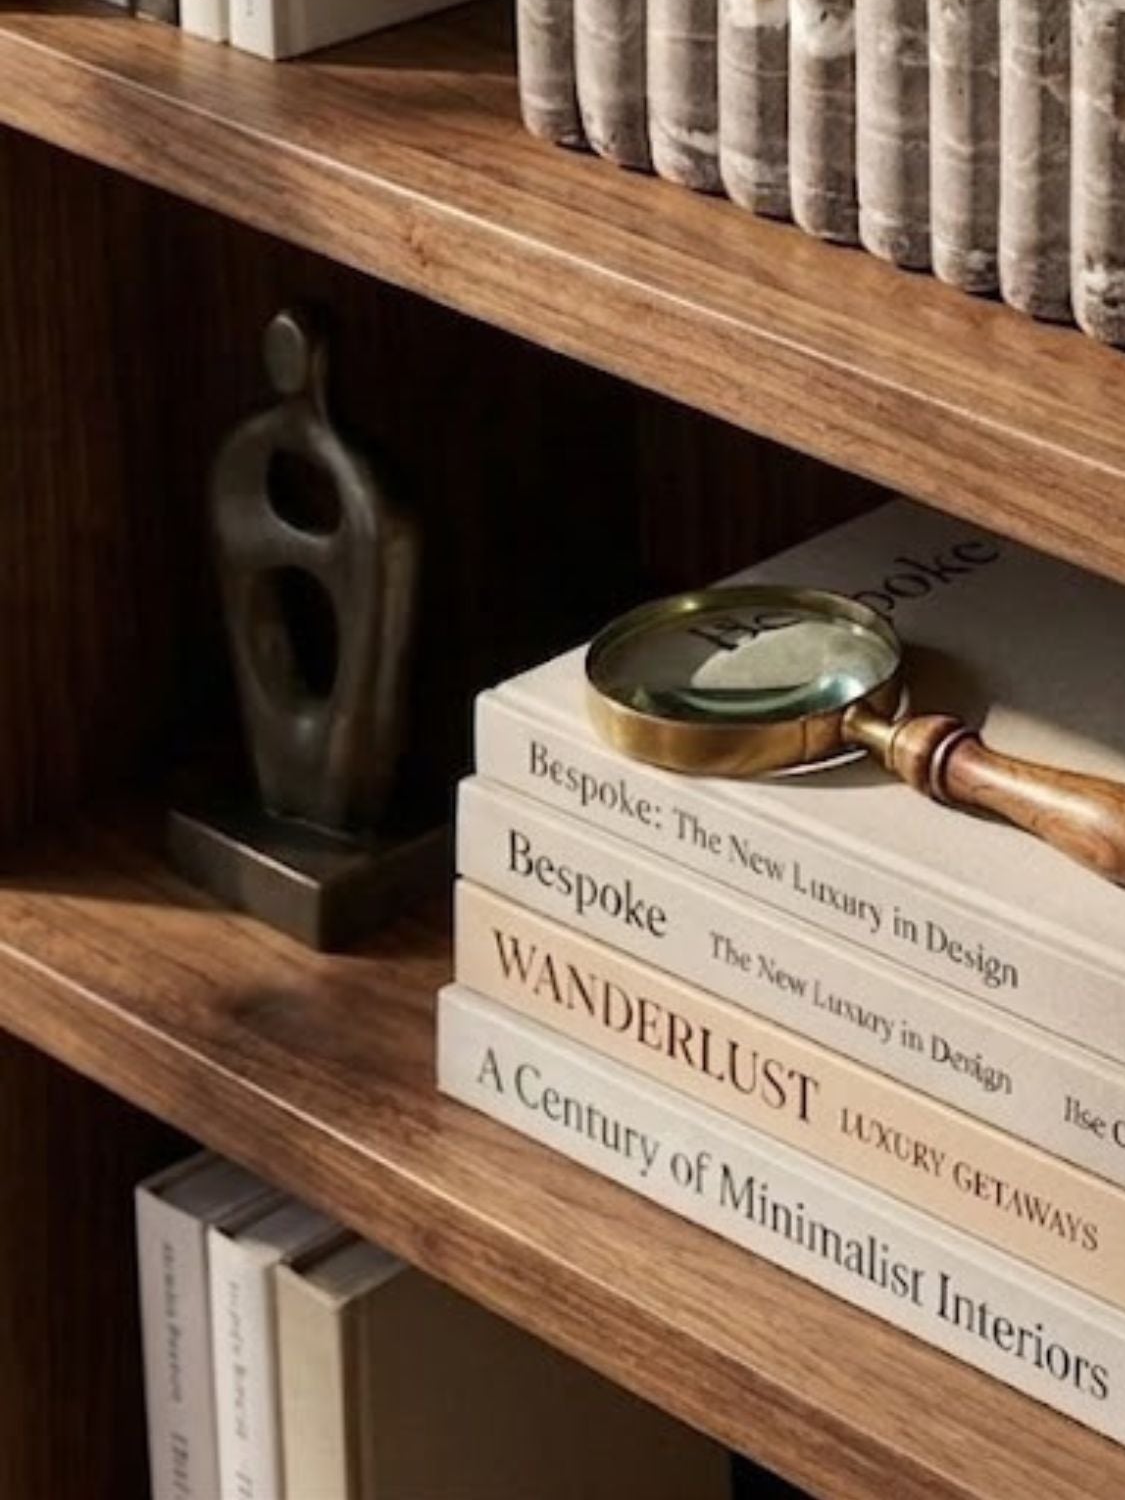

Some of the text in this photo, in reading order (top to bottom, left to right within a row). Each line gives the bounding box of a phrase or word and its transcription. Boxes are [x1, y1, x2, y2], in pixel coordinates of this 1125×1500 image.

[509, 829, 667, 938] Bespoke
[710, 930, 751, 971] The
[756, 954, 807, 998] New
[900, 1019, 924, 1052] in
[529, 740, 1018, 989] Bespoke: The New Luxury in Design
[477, 1046, 1110, 1400] A Century of Minimalist Interiors
[493, 928, 819, 1123] WANDERLUST
[952, 1161, 1098, 1251] GETAWAYS
